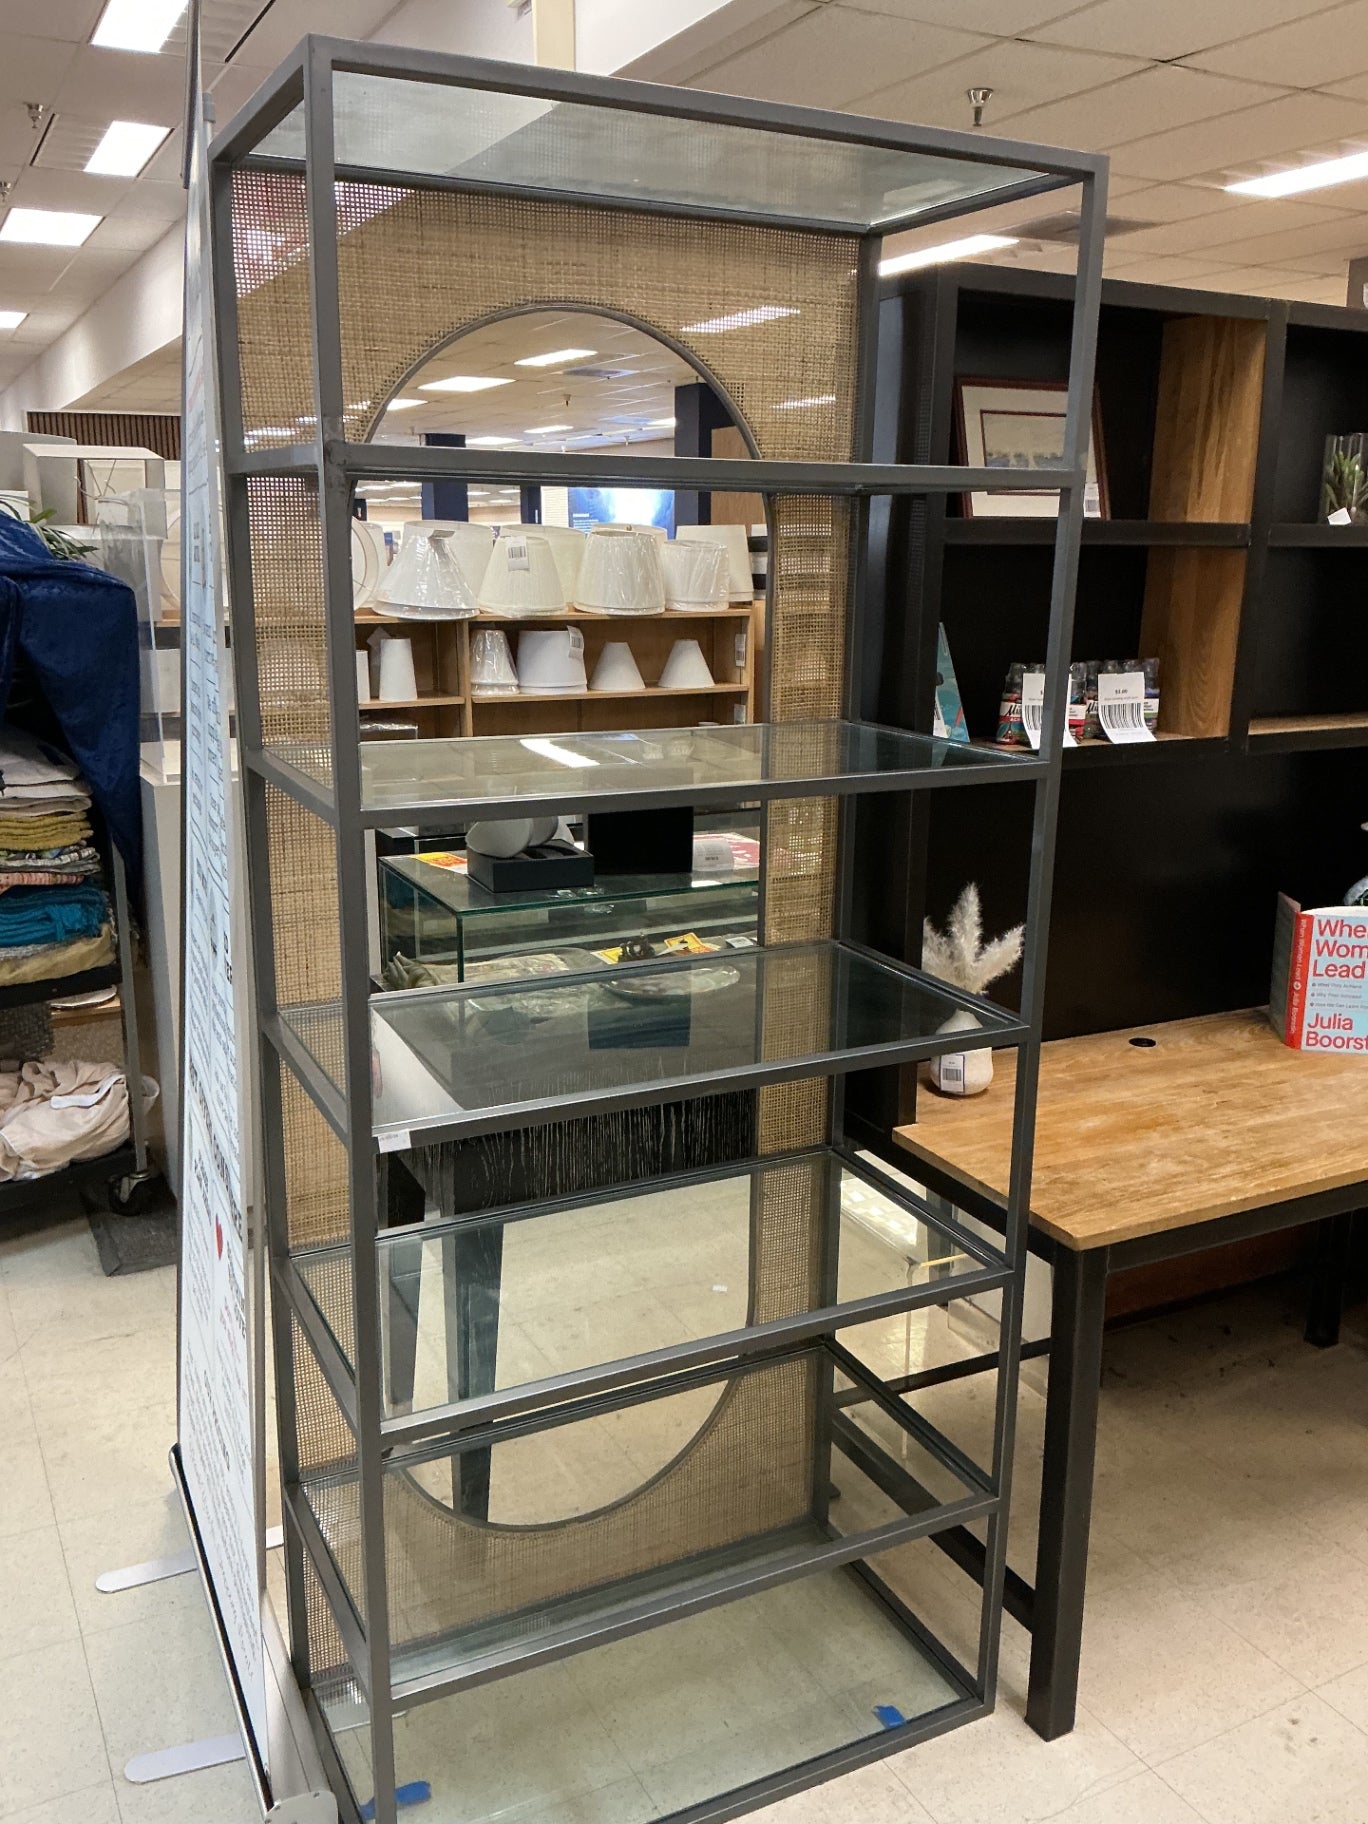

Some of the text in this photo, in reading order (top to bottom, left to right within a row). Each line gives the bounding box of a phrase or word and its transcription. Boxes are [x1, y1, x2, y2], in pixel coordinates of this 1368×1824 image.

[1317, 919, 1368, 939] Whe
[1312, 960, 1366, 980] Lead
[1307, 1012, 1354, 1031] Julia
